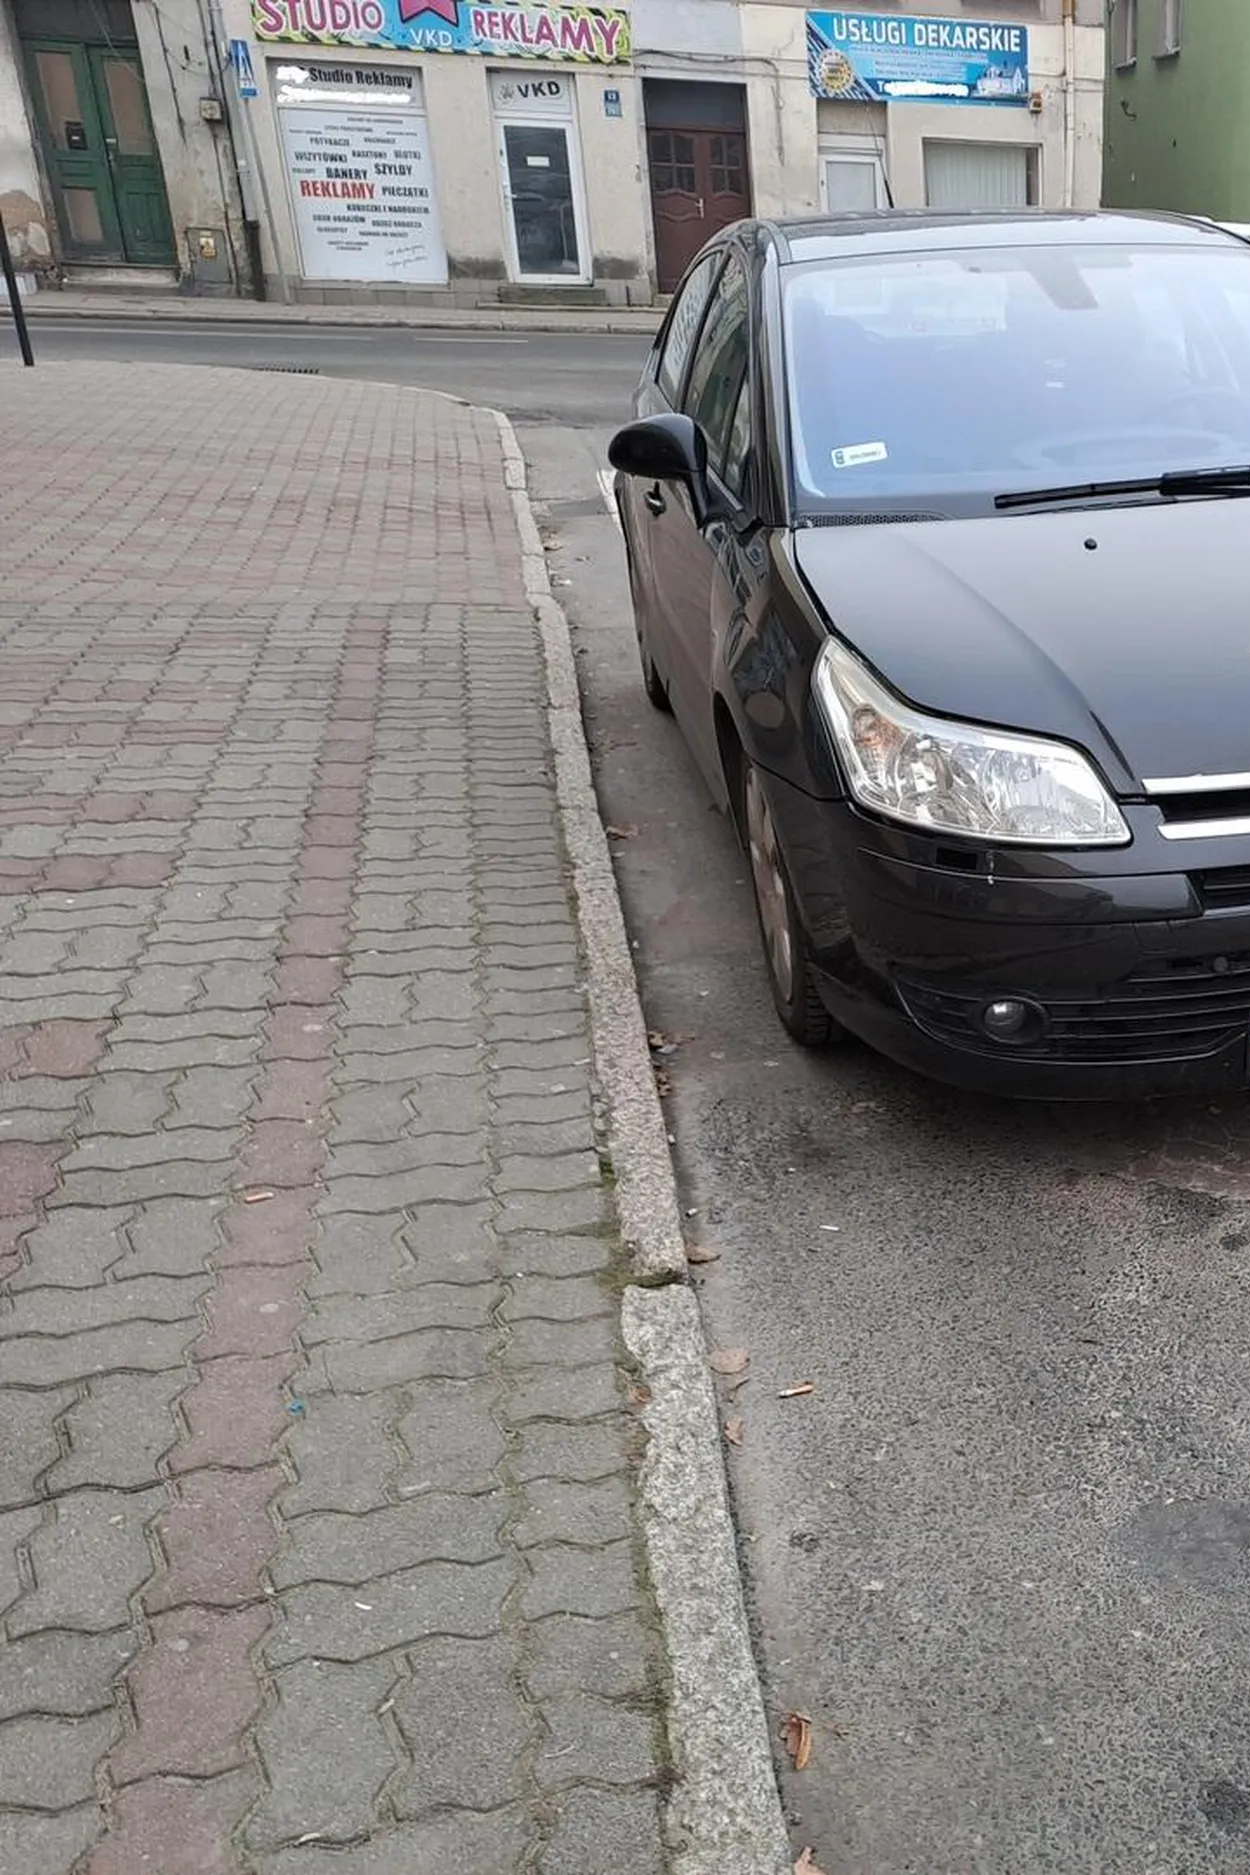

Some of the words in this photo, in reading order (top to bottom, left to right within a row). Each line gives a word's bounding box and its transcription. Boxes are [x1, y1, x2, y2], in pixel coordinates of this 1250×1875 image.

[257, 0, 384, 34] STUDIO
[410, 27, 453, 48] VKD
[472, 9, 620, 57] REKLAMY
[832, 17, 906, 45] USŁUGI
[914, 24, 1020, 51] DEKARSKIE
[309, 67, 353, 85] Studio
[355, 69, 413, 89] Reklamy
[517, 81, 561, 98] VKD
[325, 166, 368, 181] BANERY
[374, 163, 412, 176] SZYLDY
[300, 180, 375, 199] REKLAMY
